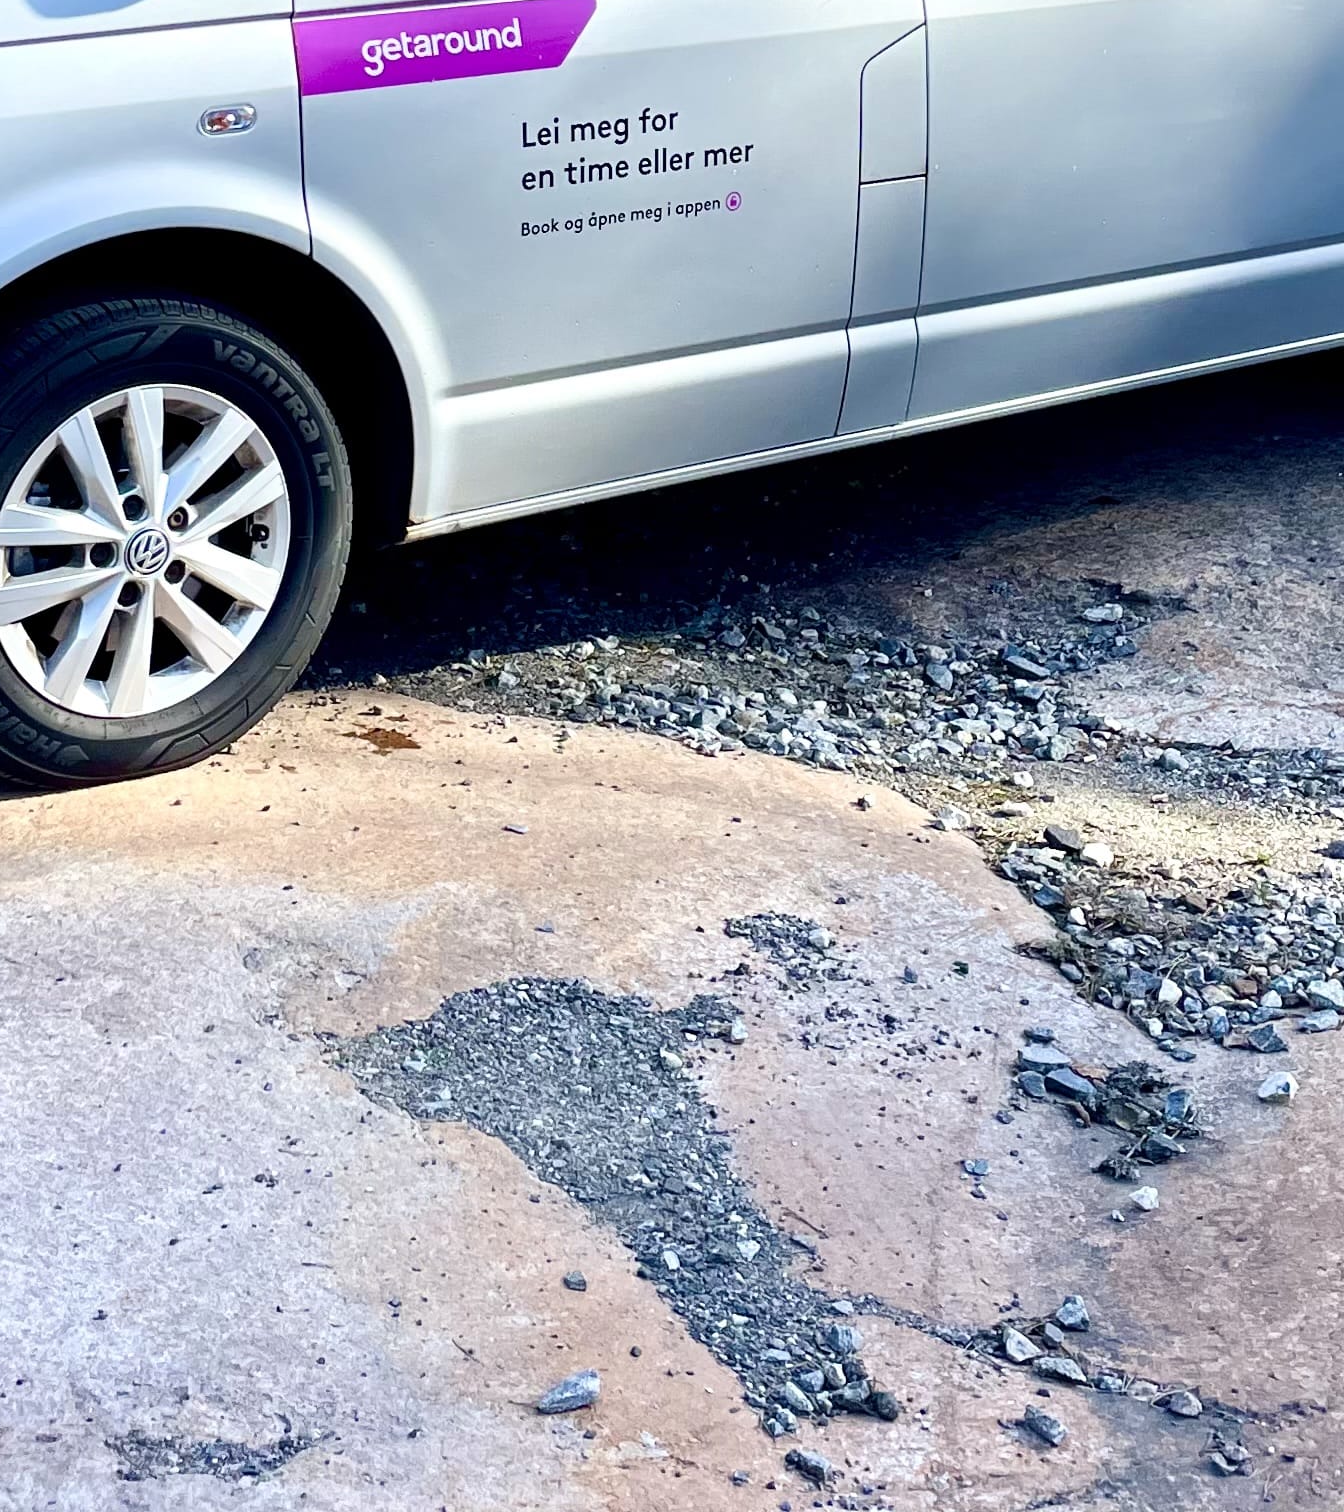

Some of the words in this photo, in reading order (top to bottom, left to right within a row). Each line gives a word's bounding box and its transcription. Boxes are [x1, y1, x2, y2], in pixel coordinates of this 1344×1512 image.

[361, 17, 523, 77] getaround
[521, 116, 560, 148] Lei
[570, 117, 629, 145] meg
[638, 107, 679, 134] for
[521, 169, 555, 191] en
[564, 156, 630, 185] time
[638, 147, 695, 175] eller
[704, 144, 754, 167] mer
[520, 218, 560, 237] Book
[564, 218, 584, 234] og
[588, 212, 626, 230] åpne
[630, 206, 663, 223] meg
[666, 201, 672, 217] i
[675, 198, 721, 218] appen
[311, 451, 337, 493] LT
